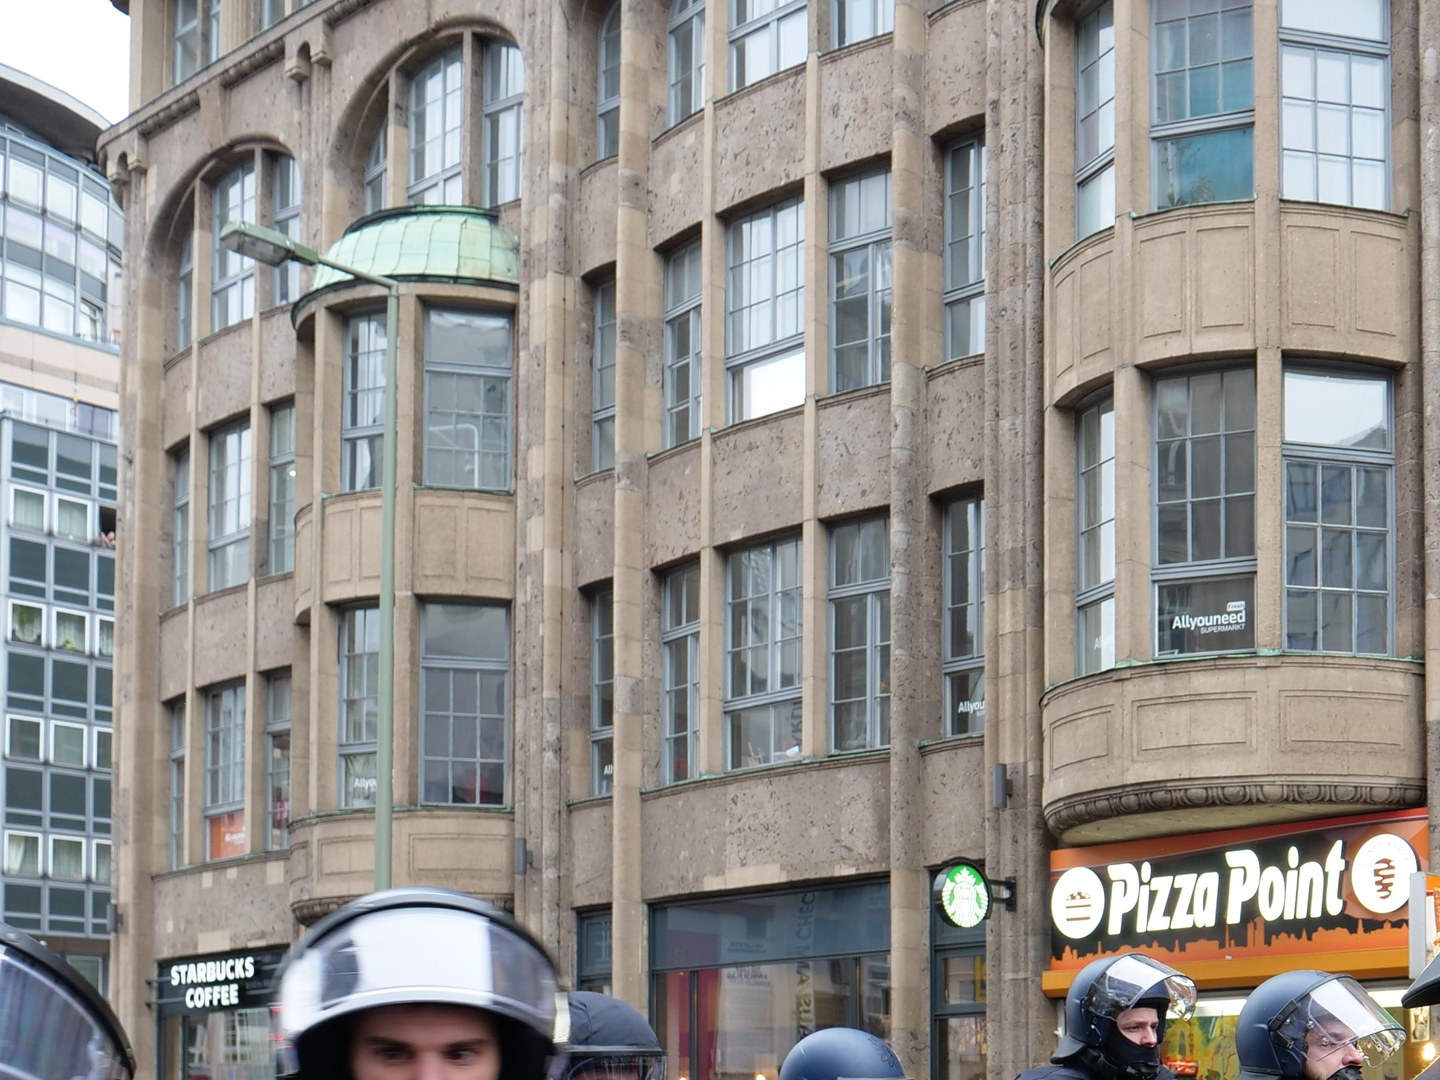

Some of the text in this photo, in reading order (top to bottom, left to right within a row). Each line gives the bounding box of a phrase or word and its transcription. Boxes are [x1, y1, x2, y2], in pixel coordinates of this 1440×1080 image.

[1172, 610, 1246, 630] Allyouneed
[1200, 623, 1246, 634] SUPERMARKT
[1107, 839, 1346, 936] Pizza Point
[170, 956, 255, 986] STARBUCKS
[185, 983, 239, 1009] COFFEE
